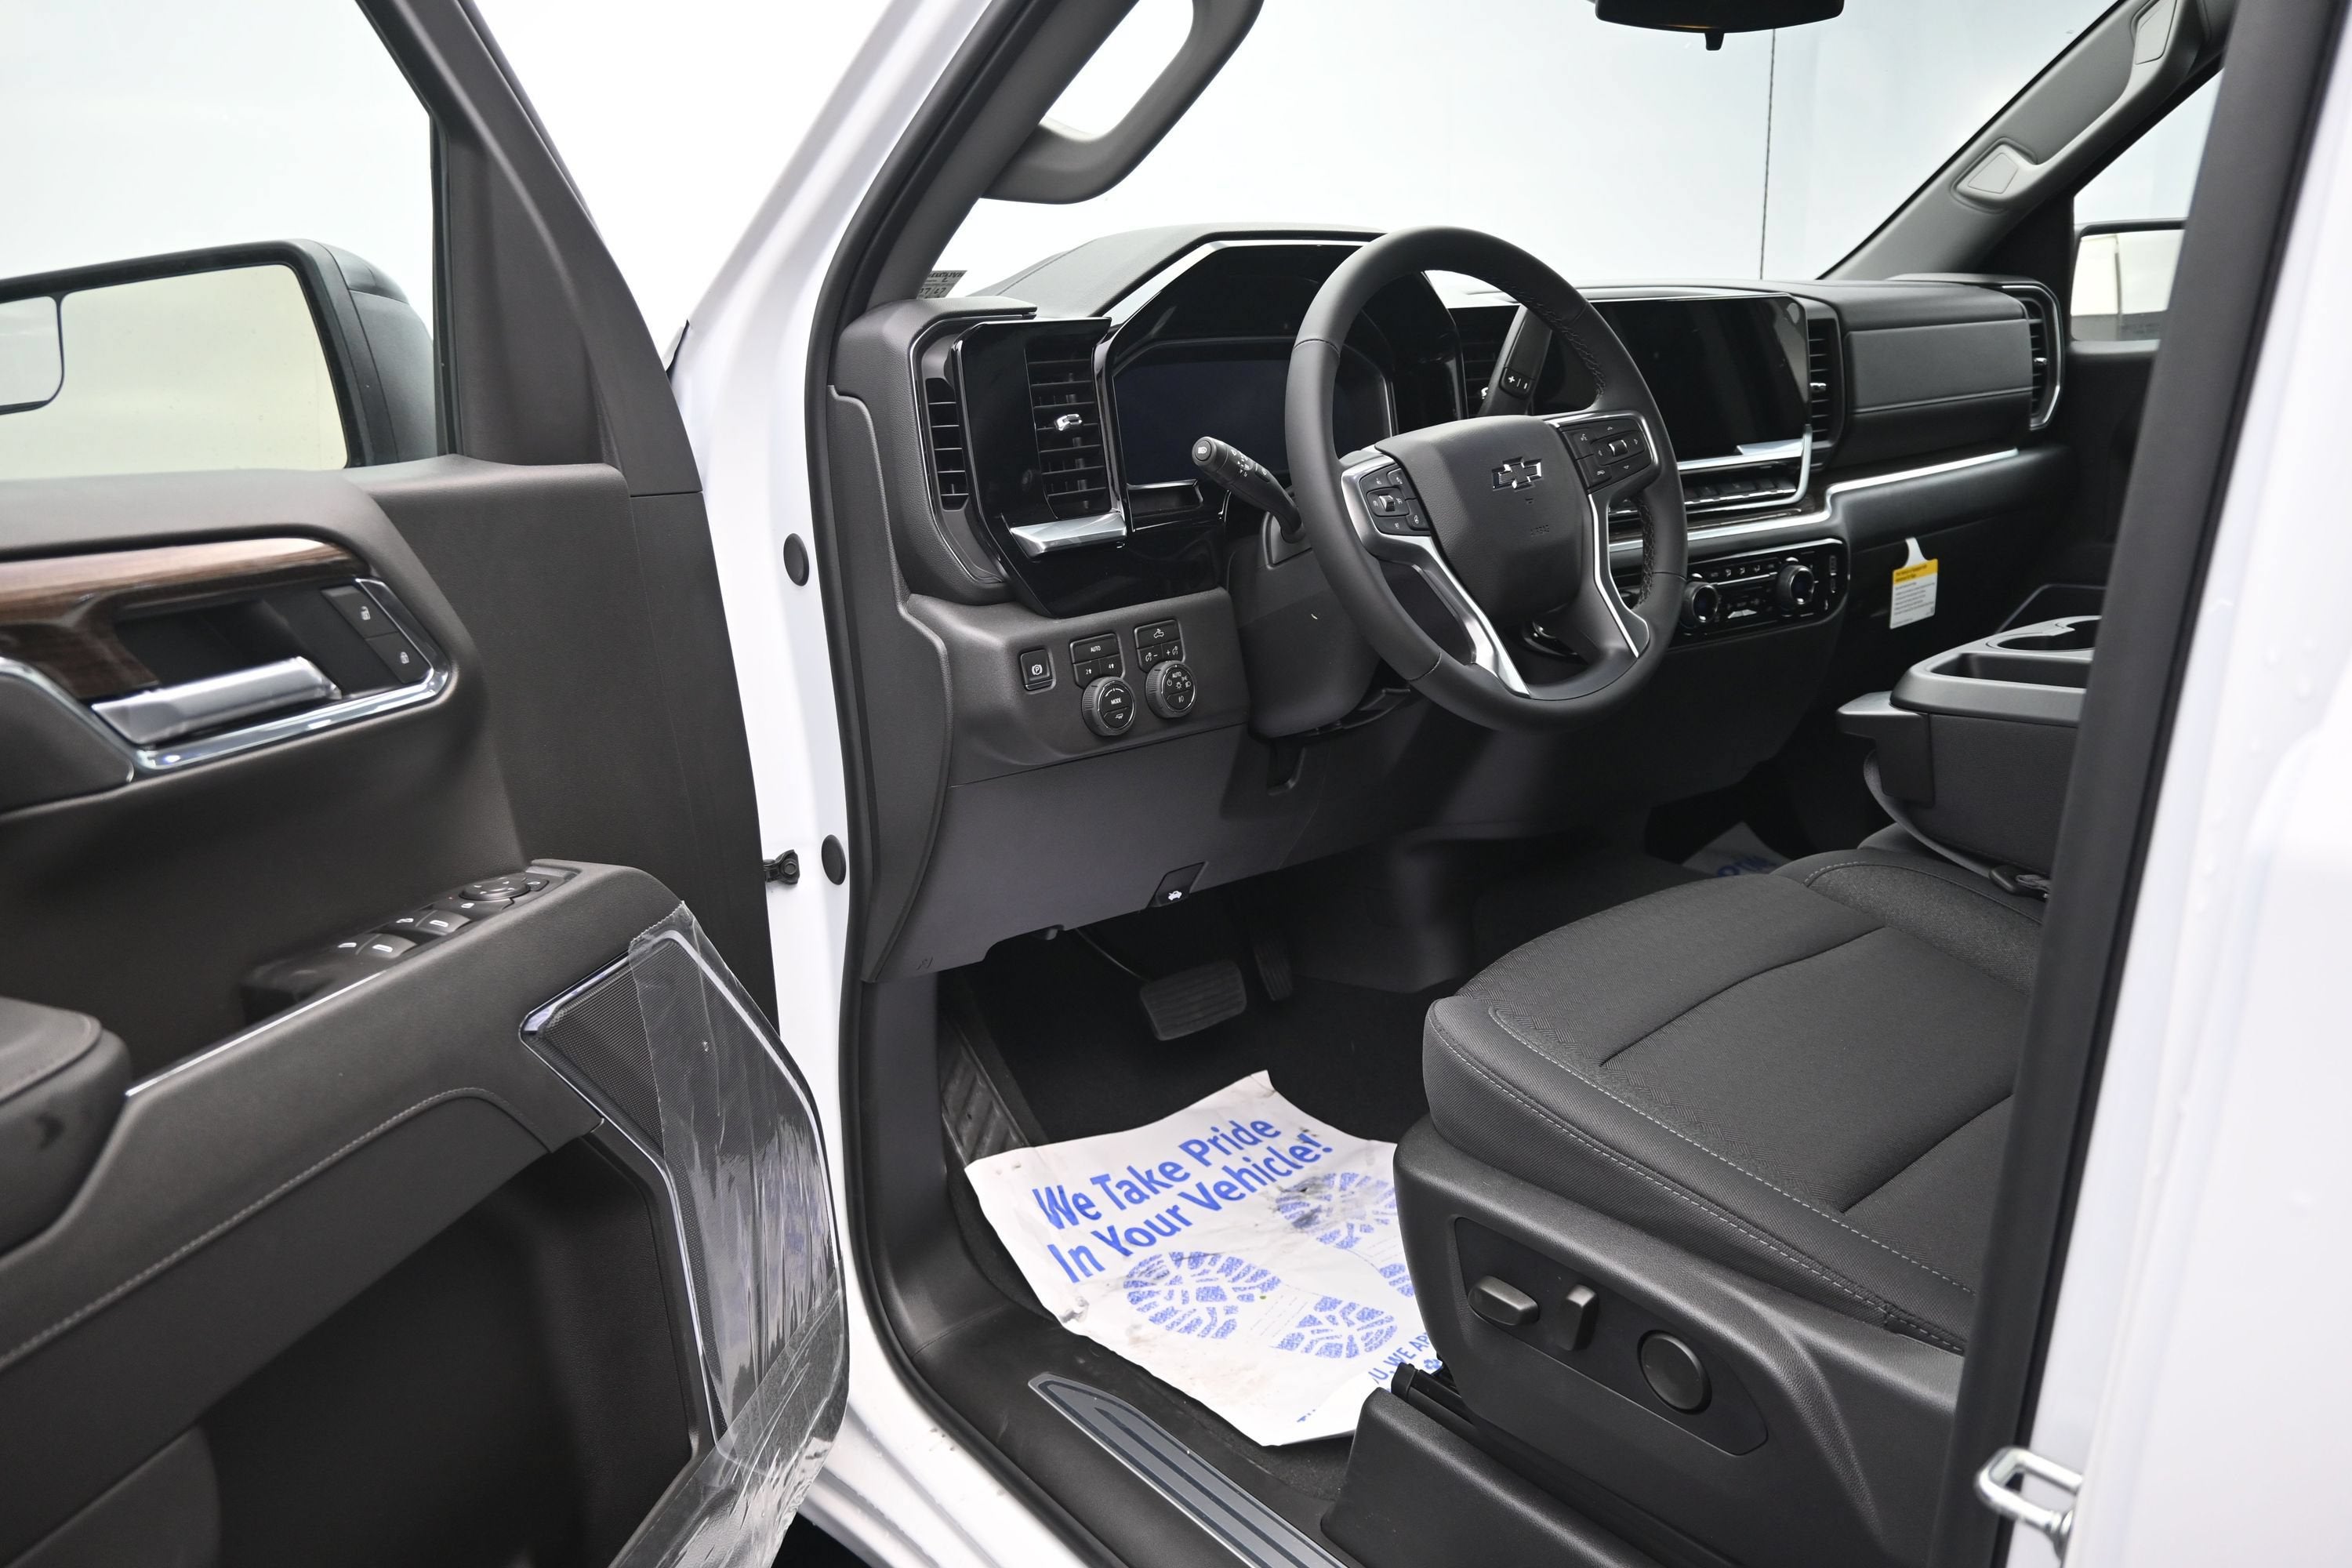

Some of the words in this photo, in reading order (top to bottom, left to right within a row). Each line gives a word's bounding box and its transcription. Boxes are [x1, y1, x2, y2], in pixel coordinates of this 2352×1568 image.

[1033, 1185, 1102, 1229] We
[1091, 1165, 1191, 1210] Take
[1178, 1120, 1281, 1167] Pride
[1047, 1243, 1105, 1283] In
[1091, 1203, 1193, 1258] Your
[1178, 1132, 1333, 1211] Vehicle!
[1383, 1347, 1417, 1367] WE
